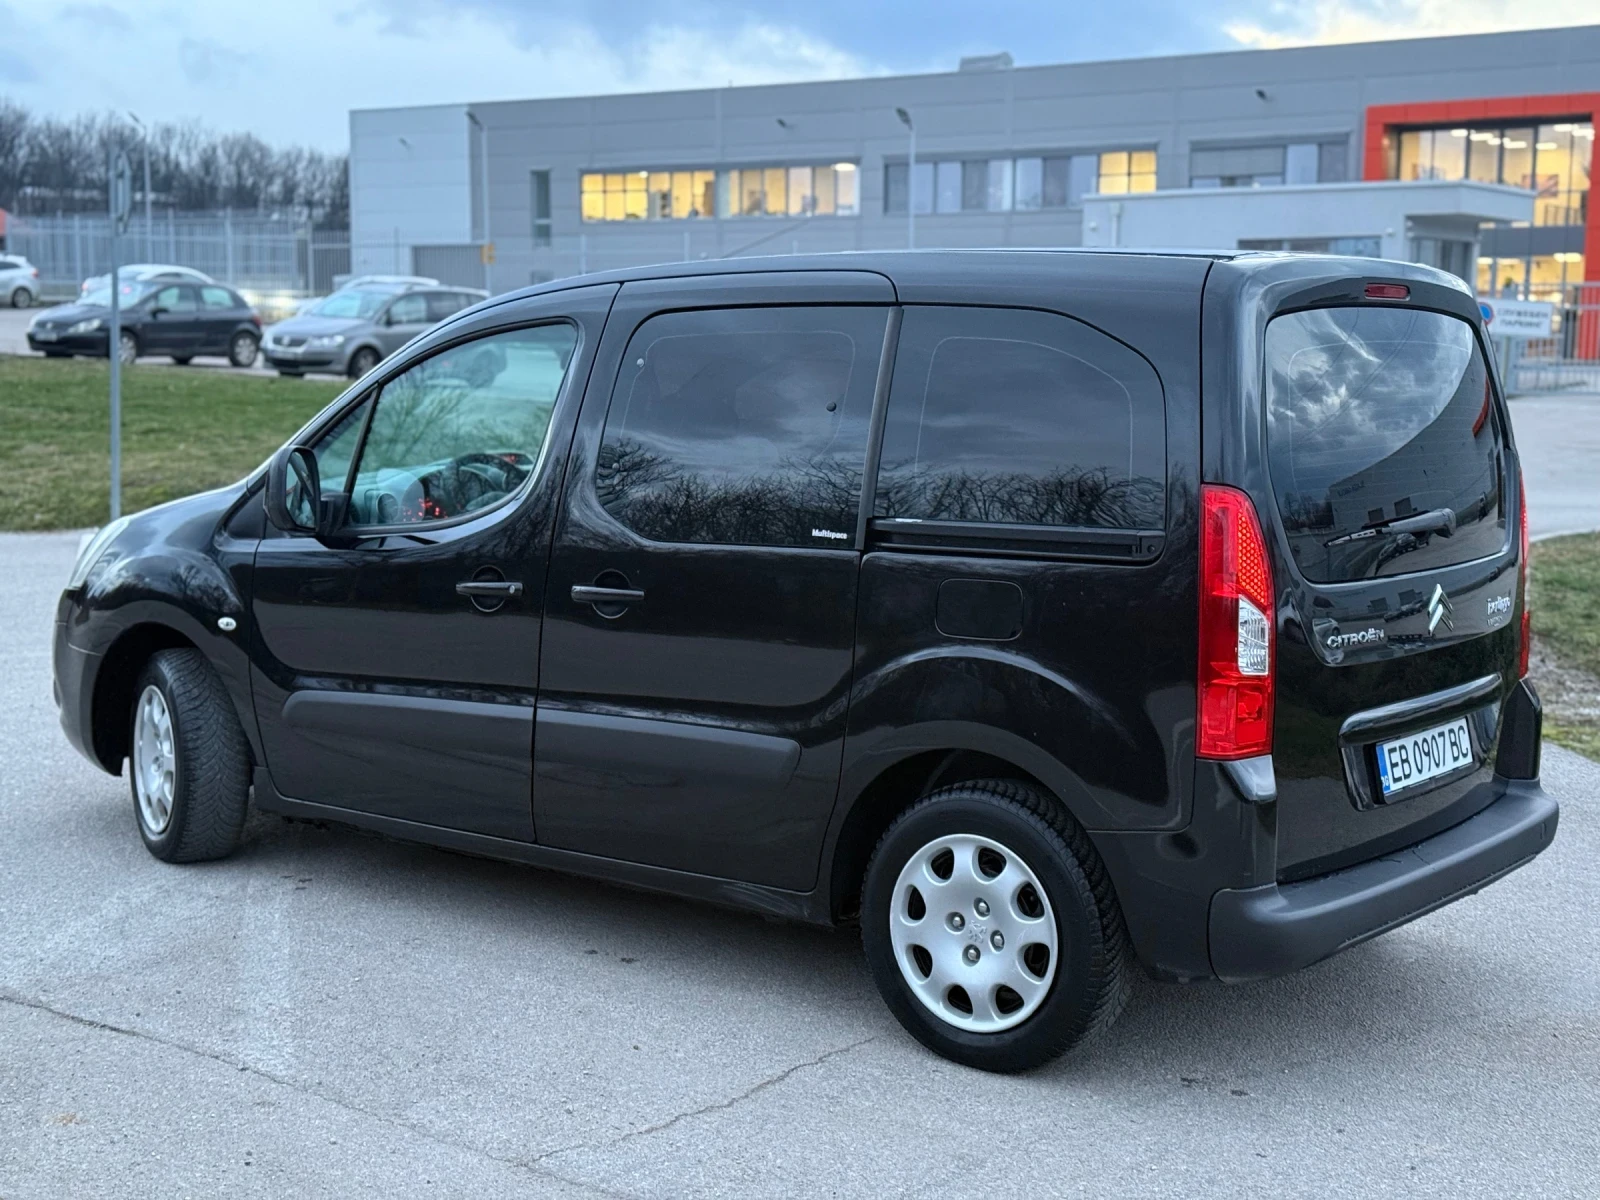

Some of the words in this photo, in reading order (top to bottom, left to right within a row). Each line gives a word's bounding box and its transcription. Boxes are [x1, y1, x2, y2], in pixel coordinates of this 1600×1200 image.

[812, 528, 847, 539] Multispace
[1327, 628, 1384, 647] CITROËN
[1387, 744, 1412, 784] EB
[1413, 731, 1446, 775] 0907
[1448, 725, 1469, 763] BC
